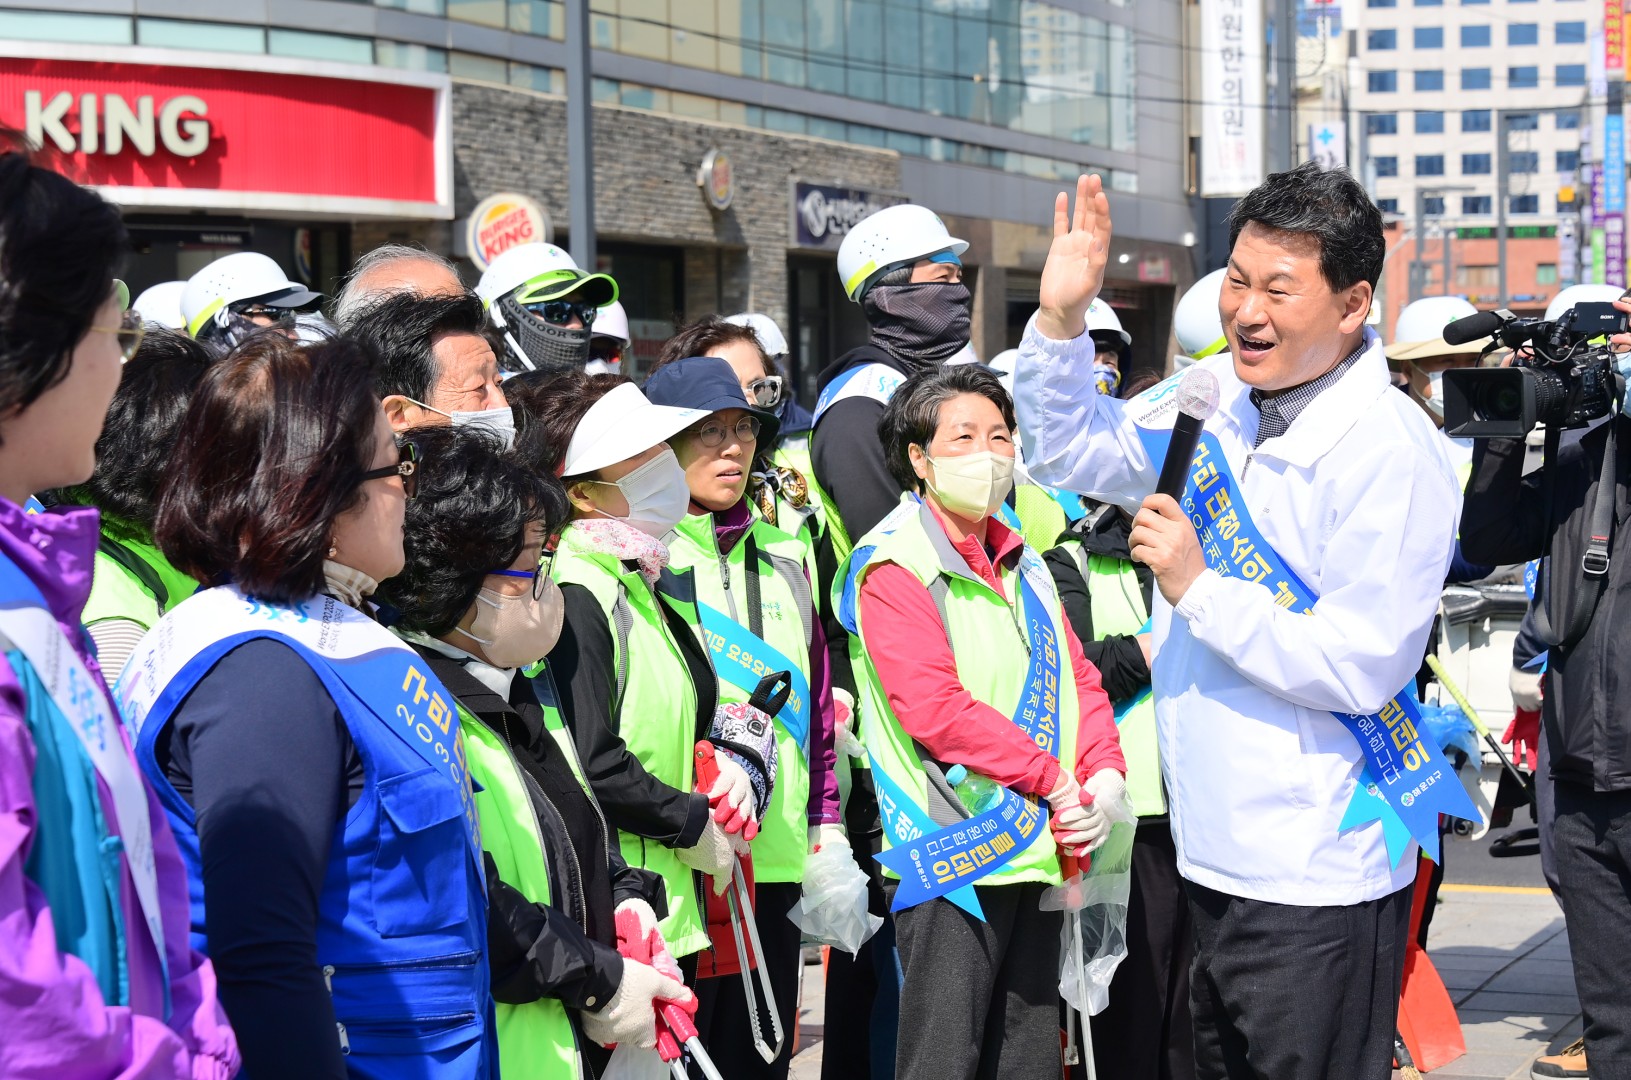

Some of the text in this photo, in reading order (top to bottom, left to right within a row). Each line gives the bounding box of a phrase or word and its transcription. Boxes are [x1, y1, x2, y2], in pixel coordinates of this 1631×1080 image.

[24, 89, 210, 157] KING
[480, 208, 528, 244] BURGER
[484, 220, 533, 264] KING
[508, 299, 567, 340] OUTDOOR
[1138, 407, 1159, 422] World
[1192, 441, 1220, 494] 구민
[1205, 487, 1273, 583] 대청소의
[402, 665, 453, 735] 구민
[1034, 624, 1057, 754] 구민 대청소의
[1411, 769, 1443, 798] 해운대구
[925, 790, 1020, 857] 치를 응원합니다
[914, 860, 932, 890] 해운대구
[932, 830, 1017, 885] 클린데이
